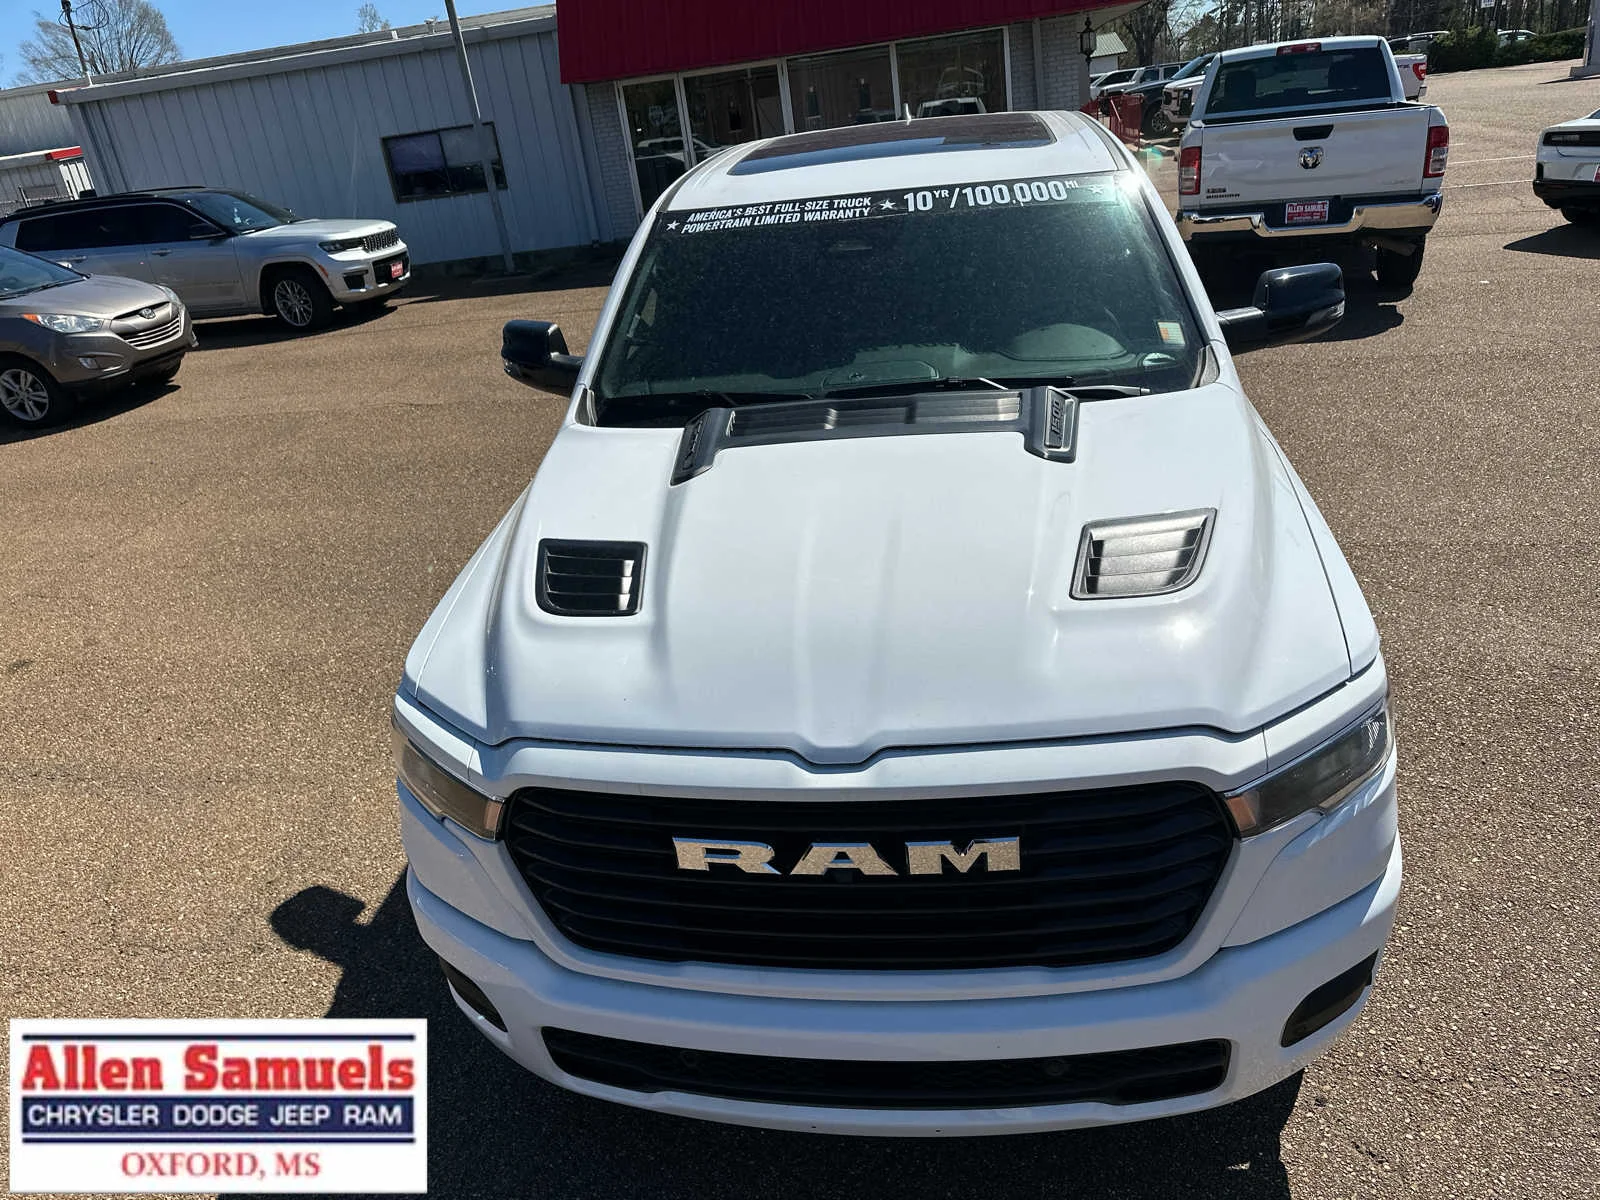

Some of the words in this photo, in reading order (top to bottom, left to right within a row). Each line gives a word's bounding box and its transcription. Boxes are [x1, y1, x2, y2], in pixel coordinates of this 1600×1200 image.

[680, 217, 753, 234] POWERTRAIN
[754, 212, 801, 226] LIMITED
[804, 207, 871, 222] WARRANTY
[686, 207, 744, 223] AMERICA'S
[744, 204, 773, 216] BEST
[774, 200, 831, 213] FULL-SIZE
[833, 197, 872, 209] TRUCK
[1051, 398, 1062, 434] 1500
[672, 836, 1021, 876] RAM
